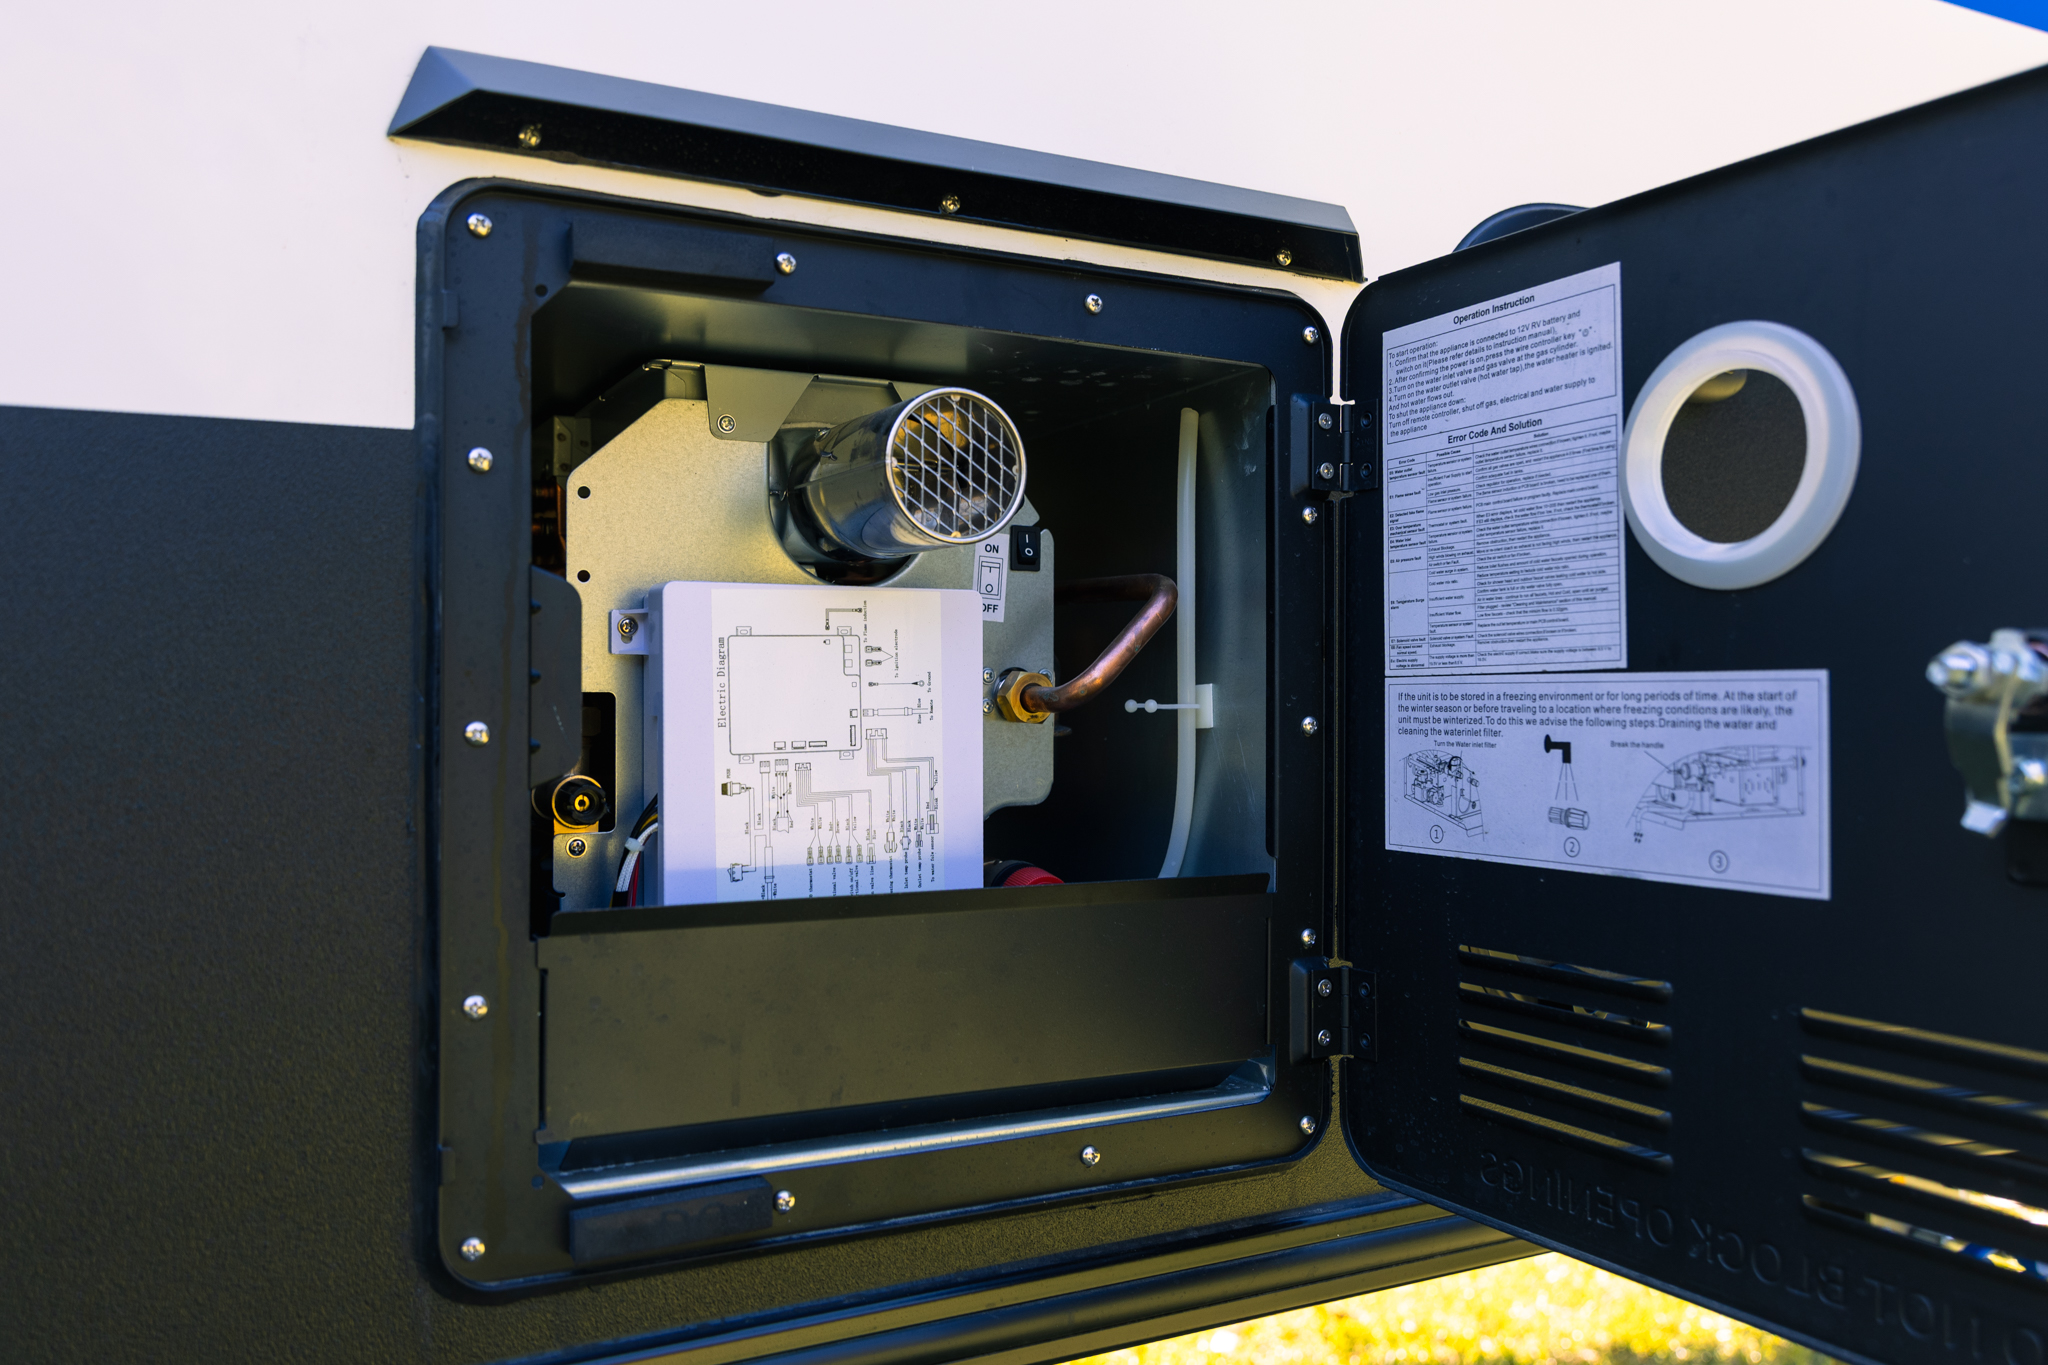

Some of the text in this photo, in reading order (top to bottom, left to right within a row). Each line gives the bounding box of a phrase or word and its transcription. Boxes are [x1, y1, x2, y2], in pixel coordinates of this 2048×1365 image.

[1453, 295, 1536, 326] Operation Instruction
[1394, 356, 1418, 368] Confirm
[1417, 351, 1430, 361] that
[1429, 350, 1440, 358] the
[1439, 341, 1470, 356] appliance
[1475, 329, 1509, 346] connected
[1517, 323, 1531, 334] 12V
[1542, 315, 1567, 327] battery
[1567, 309, 1581, 320] and
[1396, 348, 1410, 359] start
[1415, 380, 1425, 388] the
[1425, 376, 1442, 386] water
[1442, 372, 1456, 382] inlet
[1456, 368, 1473, 378] valve
[1473, 364, 1486, 374] and
[1485, 362, 1498, 372] gas
[1498, 357, 1516, 367] valve
[1524, 352, 1536, 361] the
[1536, 349, 1549, 360] gas
[1415, 389, 1426, 398] the
[1425, 385, 1442, 395] water
[1442, 380, 1460, 391] outlet
[1460, 376, 1478, 386] valve
[1490, 368, 1510, 379] water
[1535, 357, 1556, 368] water
[1555, 351, 1579, 362] heater
[1388, 403, 1400, 412] And
[1400, 401, 1410, 410] hot
[1410, 397, 1427, 407] water
[1426, 394, 1443, 403] flows
[1388, 421, 1402, 430] Turn
[1402, 417, 1411, 427] off
[1410, 414, 1431, 425] remote
[1461, 403, 1476, 414] shut
[1475, 400, 1486, 410] off
[1499, 391, 1530, 405] electrical
[1530, 387, 1544, 398] and
[1544, 384, 1564, 395] water
[1564, 378, 1588, 390] supply
[1396, 410, 1409, 420] shut
[1409, 408, 1419, 416] the
[1419, 402, 1448, 415] appliance
[1390, 424, 1428, 438] the appliance
[1447, 418, 1543, 445] Error Code And Solution
[984, 544, 999, 554] ON
[716, 637, 726, 728] Electric Diagram
[1404, 692, 1417, 702] the
[1417, 692, 1432, 702] unit
[1460, 692, 1486, 702] stored
[1502, 691, 1538, 704] freezing
[1538, 691, 1594, 702] environment
[1606, 691, 1620, 702] for
[1621, 691, 1643, 704] long
[1644, 691, 1682, 703] periods
[1737, 691, 1755, 702] the
[1757, 691, 1784, 702] start
[1397, 703, 1410, 713] the
[1410, 703, 1434, 714] winter
[1434, 705, 1463, 714] season
[1473, 703, 1500, 714] before
[1500, 704, 1538, 716] traveling
[1556, 704, 1592, 715] location
[1593, 704, 1622, 715] where
[1623, 704, 1664, 718] freezing
[1665, 705, 1719, 716] conditions
[1720, 706, 1739, 716] are
[1774, 705, 1794, 716] the
[1397, 715, 1412, 725] unit
[1412, 716, 1432, 726] must
[1508, 716, 1524, 726] this
[1539, 716, 1568, 727] advise
[1569, 717, 1585, 728] the
[1585, 717, 1628, 731] following
[1703, 719, 1721, 730] the
[1723, 720, 1754, 730] water
[1755, 720, 1777, 731] and
[1397, 726, 1430, 738] cleaning
[1430, 727, 1443, 737] the
[1443, 727, 1483, 738] waterinlet
[1433, 739, 1446, 748] Turn
[1484, 741, 1498, 749] filter
